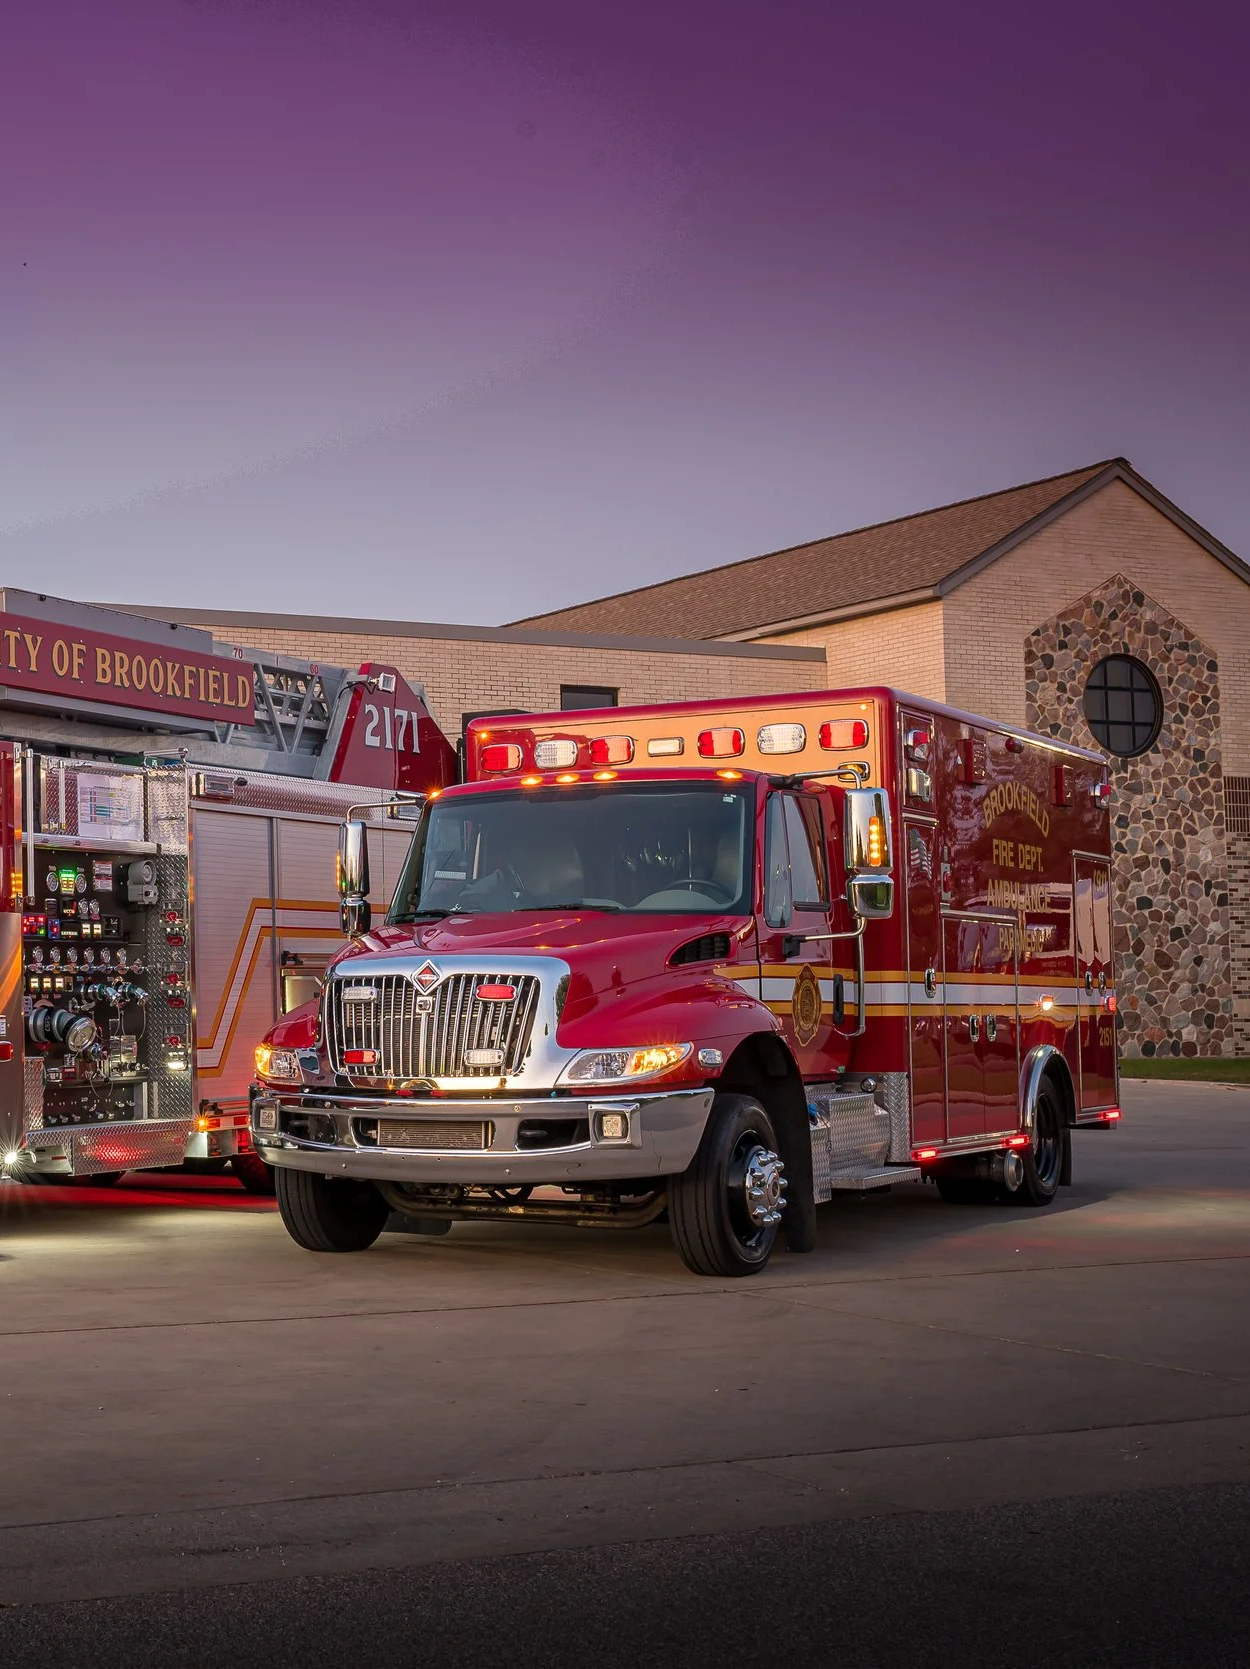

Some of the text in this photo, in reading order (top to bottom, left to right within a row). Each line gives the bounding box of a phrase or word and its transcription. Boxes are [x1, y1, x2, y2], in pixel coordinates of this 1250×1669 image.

[233, 647, 244, 659] 70
[309, 664, 319, 675] 60
[51, 639, 87, 680] OF
[95, 647, 251, 709] BROOKFIELD
[364, 703, 421, 754] 2171
[982, 781, 1050, 839] BROOKFIELD
[992, 838, 1044, 873] FIRE DEPT.
[986, 878, 1052, 913] AMBULANCE
[1098, 1026, 1113, 1047] 2151
